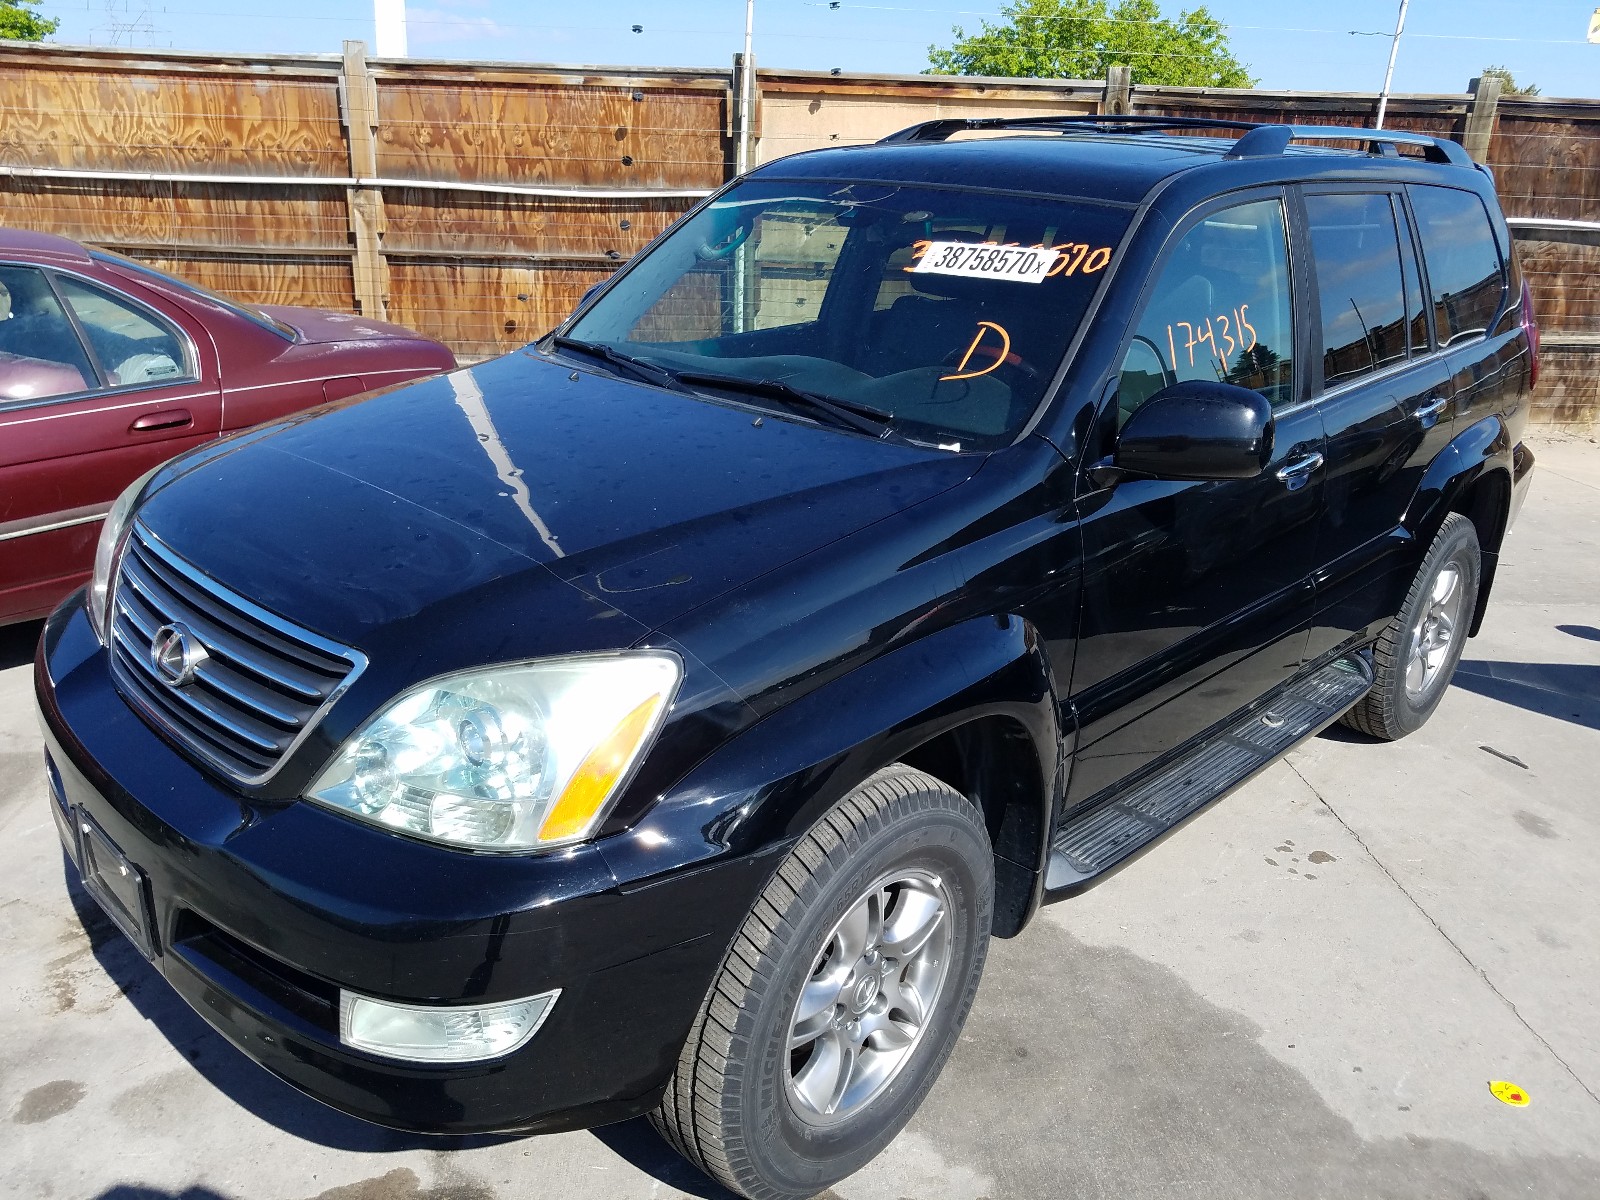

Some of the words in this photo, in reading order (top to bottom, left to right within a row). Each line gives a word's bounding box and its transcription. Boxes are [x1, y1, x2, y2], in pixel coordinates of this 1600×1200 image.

[939, 321, 1010, 381] D
[955, 912, 991, 1028] MICHELIN
[759, 968, 803, 1111] MICHELIN
